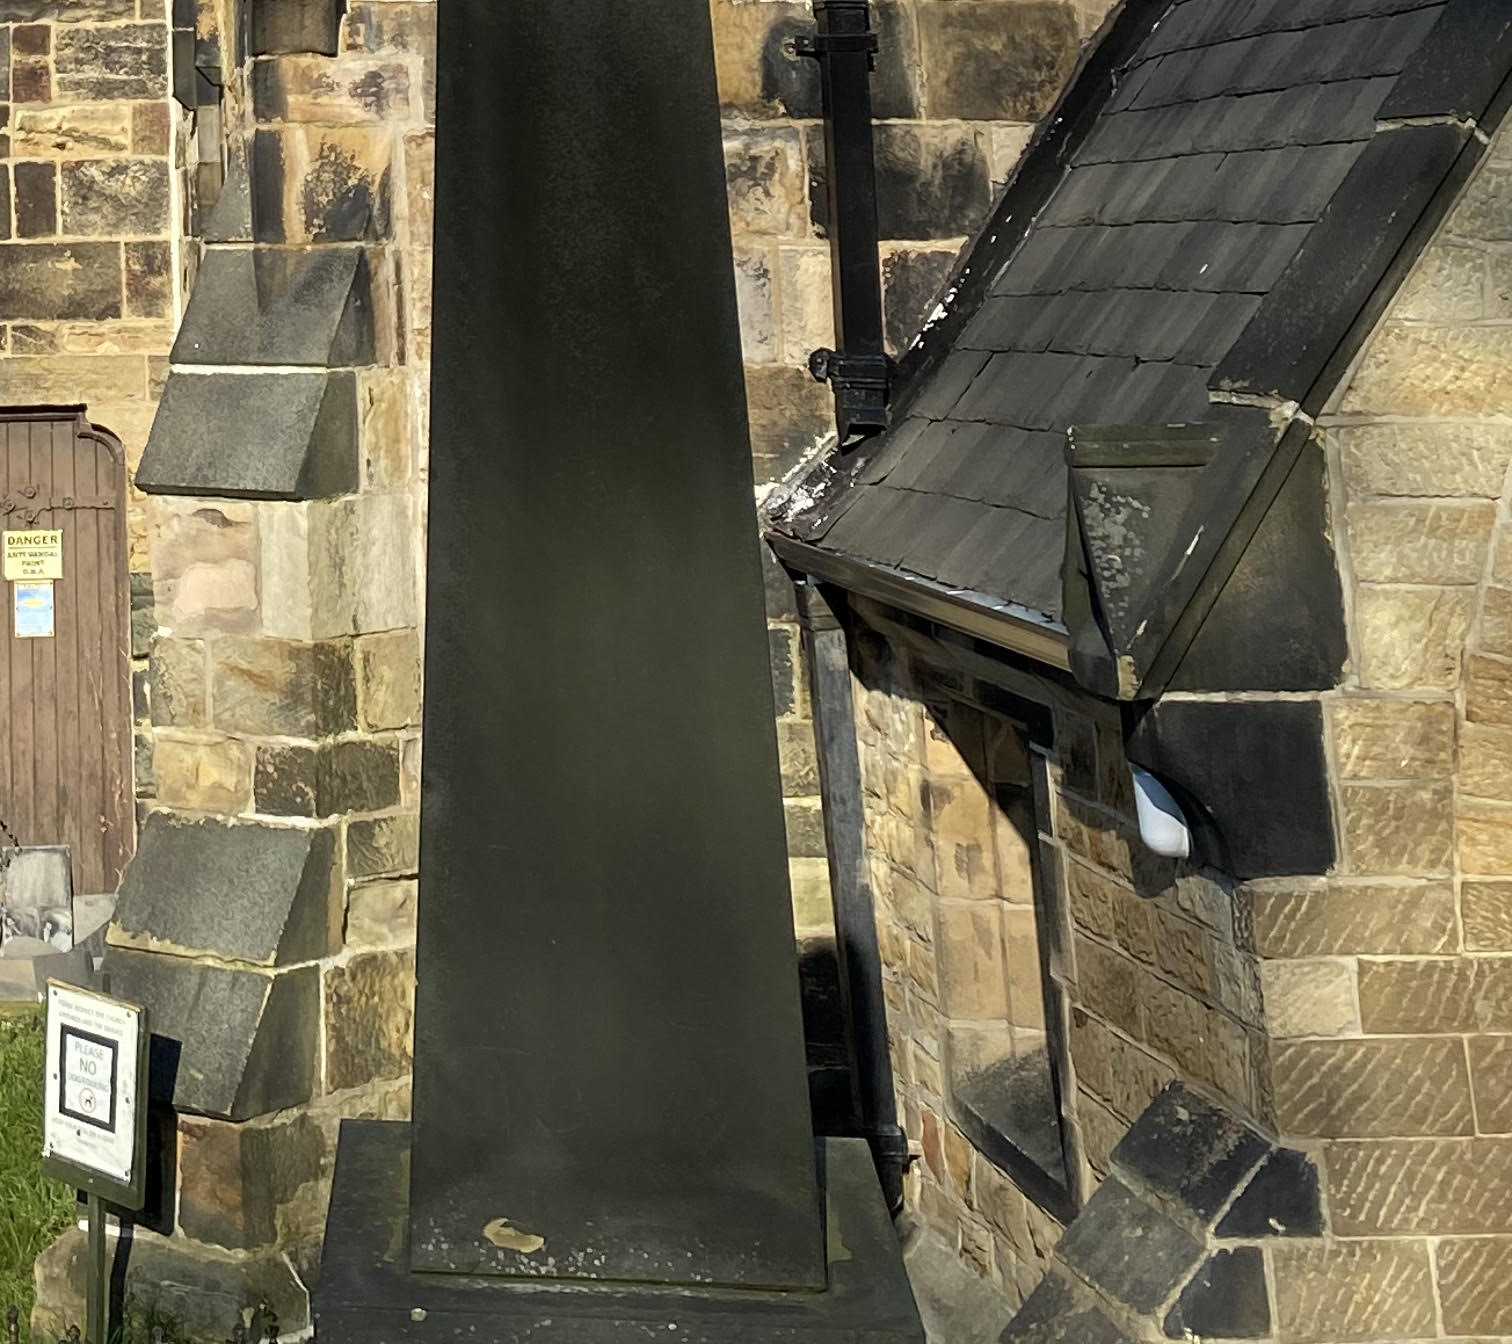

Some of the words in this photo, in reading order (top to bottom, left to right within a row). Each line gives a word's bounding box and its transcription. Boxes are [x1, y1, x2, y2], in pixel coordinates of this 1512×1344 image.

[7, 535, 58, 545] DANGER
[74, 1040, 105, 1061] PLEASE
[79, 1057, 97, 1076] NO
